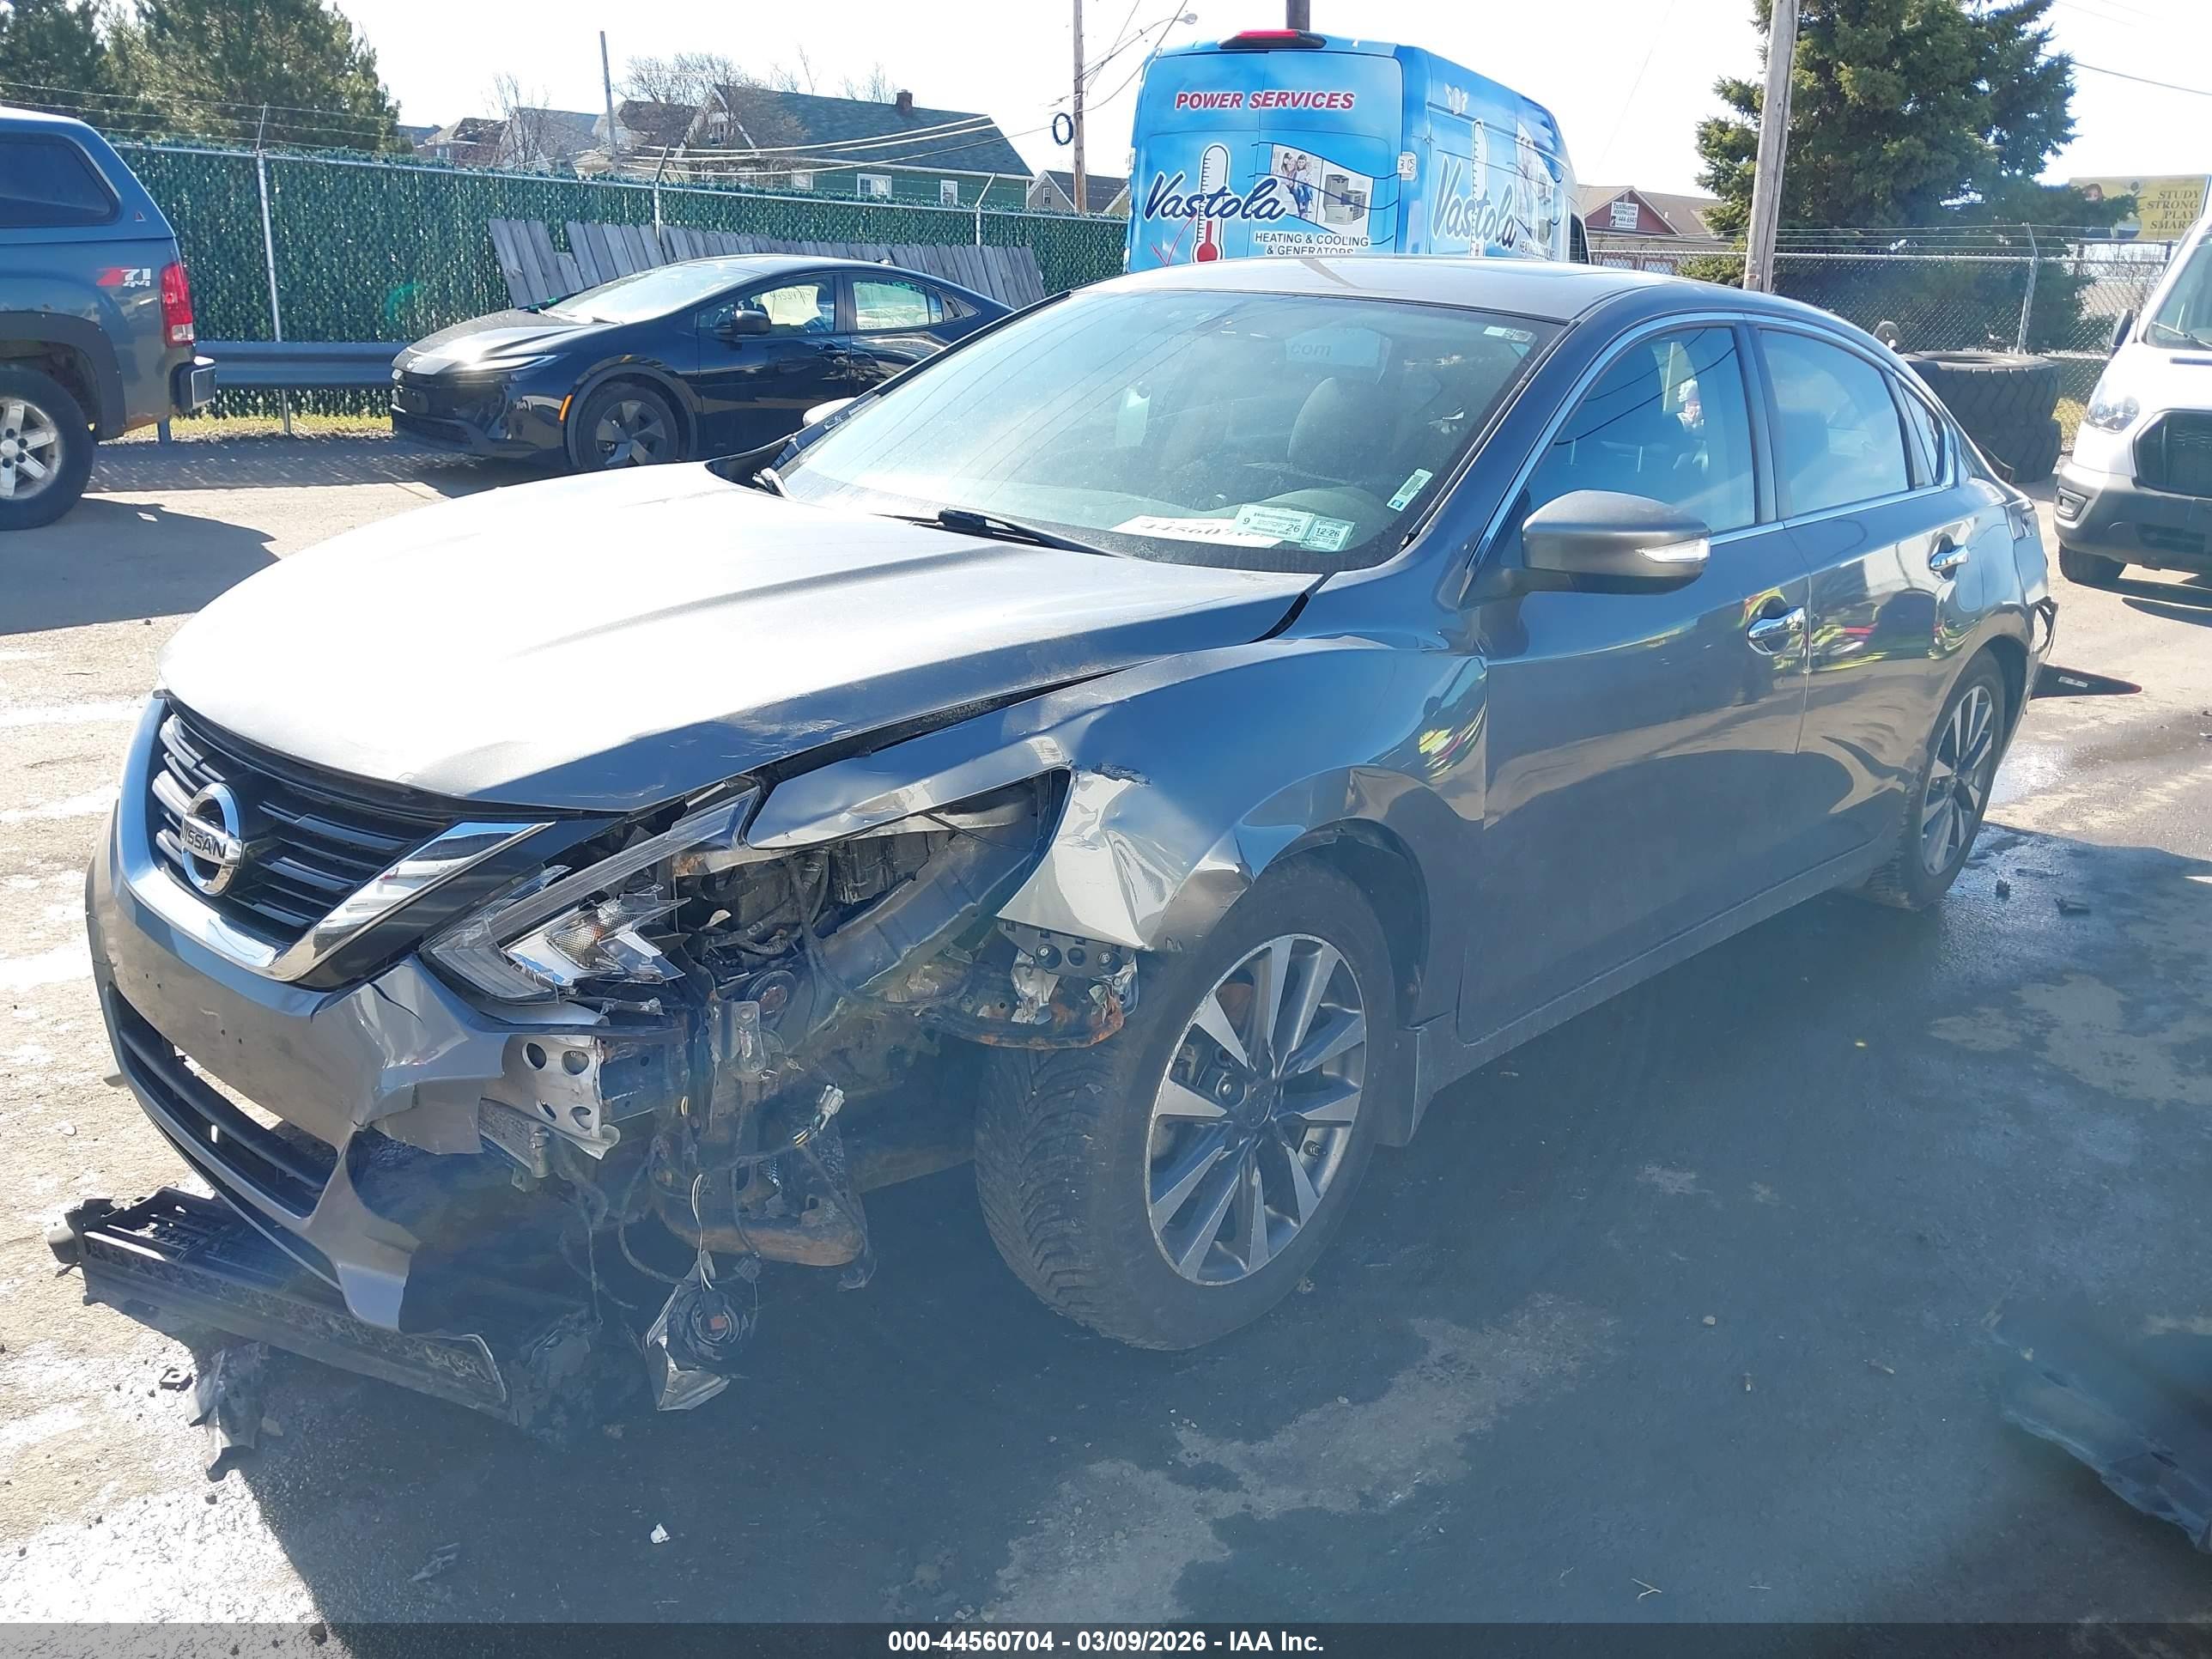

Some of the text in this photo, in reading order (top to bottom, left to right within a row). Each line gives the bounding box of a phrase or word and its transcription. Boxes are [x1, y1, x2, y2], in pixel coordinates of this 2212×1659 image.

[1176, 91, 1355, 109] POWER SERVICES
[1145, 174, 1286, 220] Vastola
[2158, 190, 2200, 199] STUDY
[1433, 157, 1516, 248] Vastola
[2147, 200, 2198, 210] STRONG
[2164, 210, 2197, 219] PLAY
[2150, 221, 2193, 229] SMART
[1255, 234, 1369, 246] HEATING & COOLING
[1291, 343, 1332, 357] com
[1286, 524, 1301, 532] 26
[182, 826, 227, 859] NISSAN
